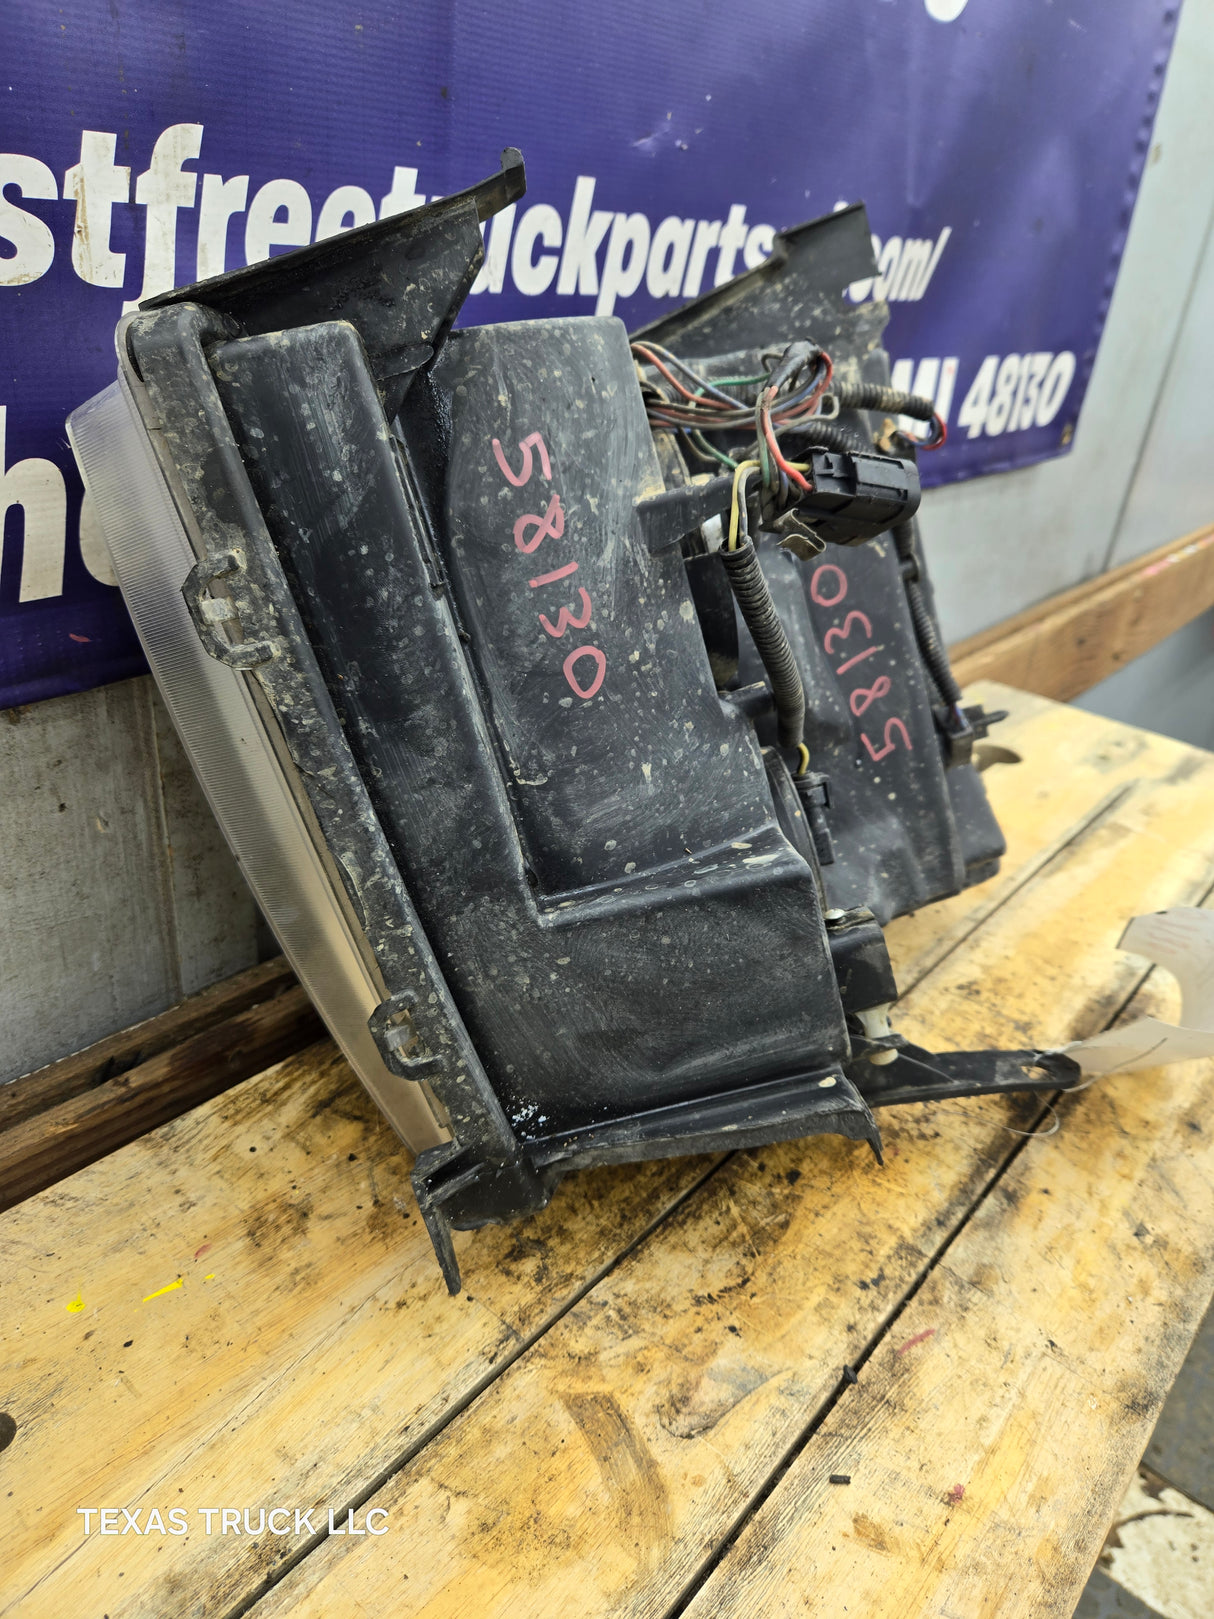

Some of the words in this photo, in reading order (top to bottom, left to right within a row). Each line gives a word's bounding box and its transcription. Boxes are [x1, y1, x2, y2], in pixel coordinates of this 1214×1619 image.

[958, 350, 1077, 439] 48130
[492, 431, 606, 699] 58130
[811, 563, 913, 762] 58130
